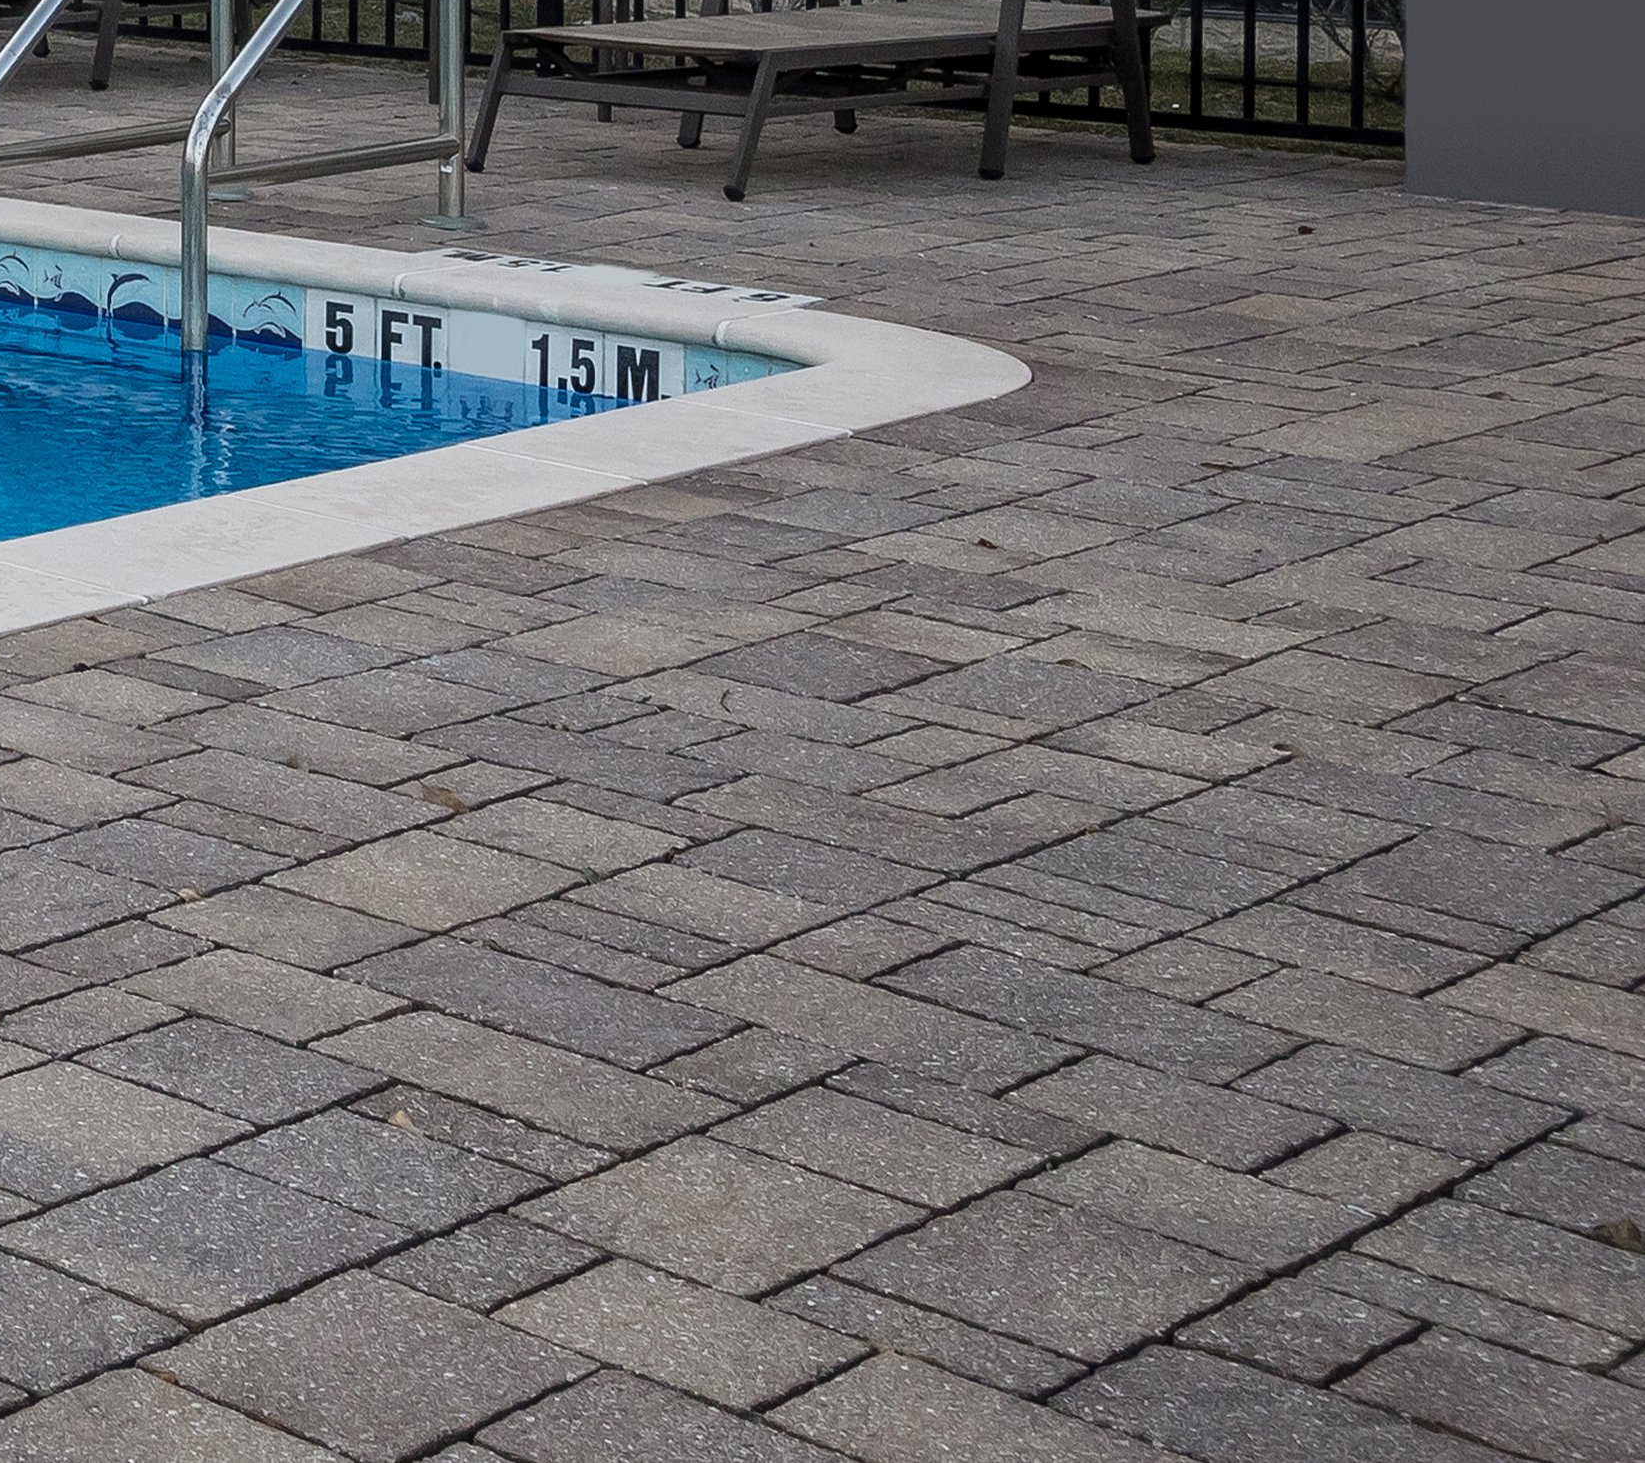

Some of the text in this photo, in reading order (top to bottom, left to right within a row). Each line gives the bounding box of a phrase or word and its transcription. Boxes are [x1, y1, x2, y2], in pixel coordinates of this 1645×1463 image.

[325, 301, 672, 405] 5 FT. 1.5 M
